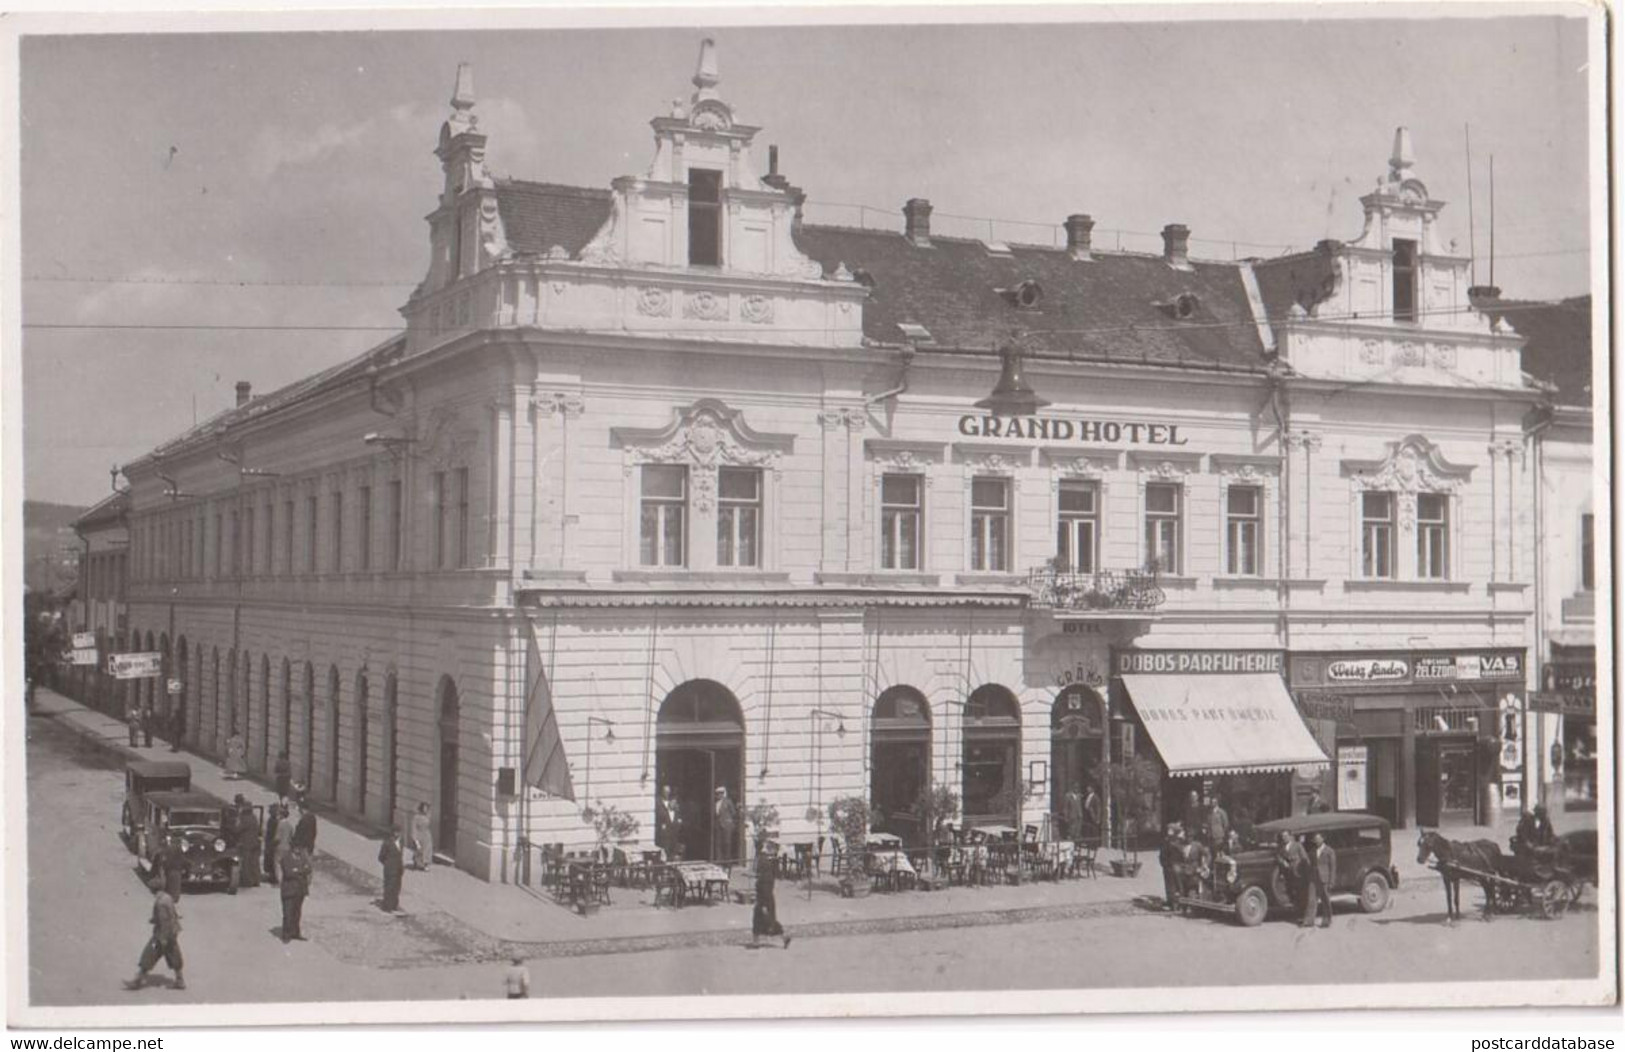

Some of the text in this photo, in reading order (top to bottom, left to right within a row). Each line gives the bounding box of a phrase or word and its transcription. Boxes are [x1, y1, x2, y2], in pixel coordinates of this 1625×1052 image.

[957, 414, 1189, 446] GRAND HOTEL
[1120, 653, 1280, 672] DOBOS PARFUMERIE
[1481, 656, 1518, 670] VAS
